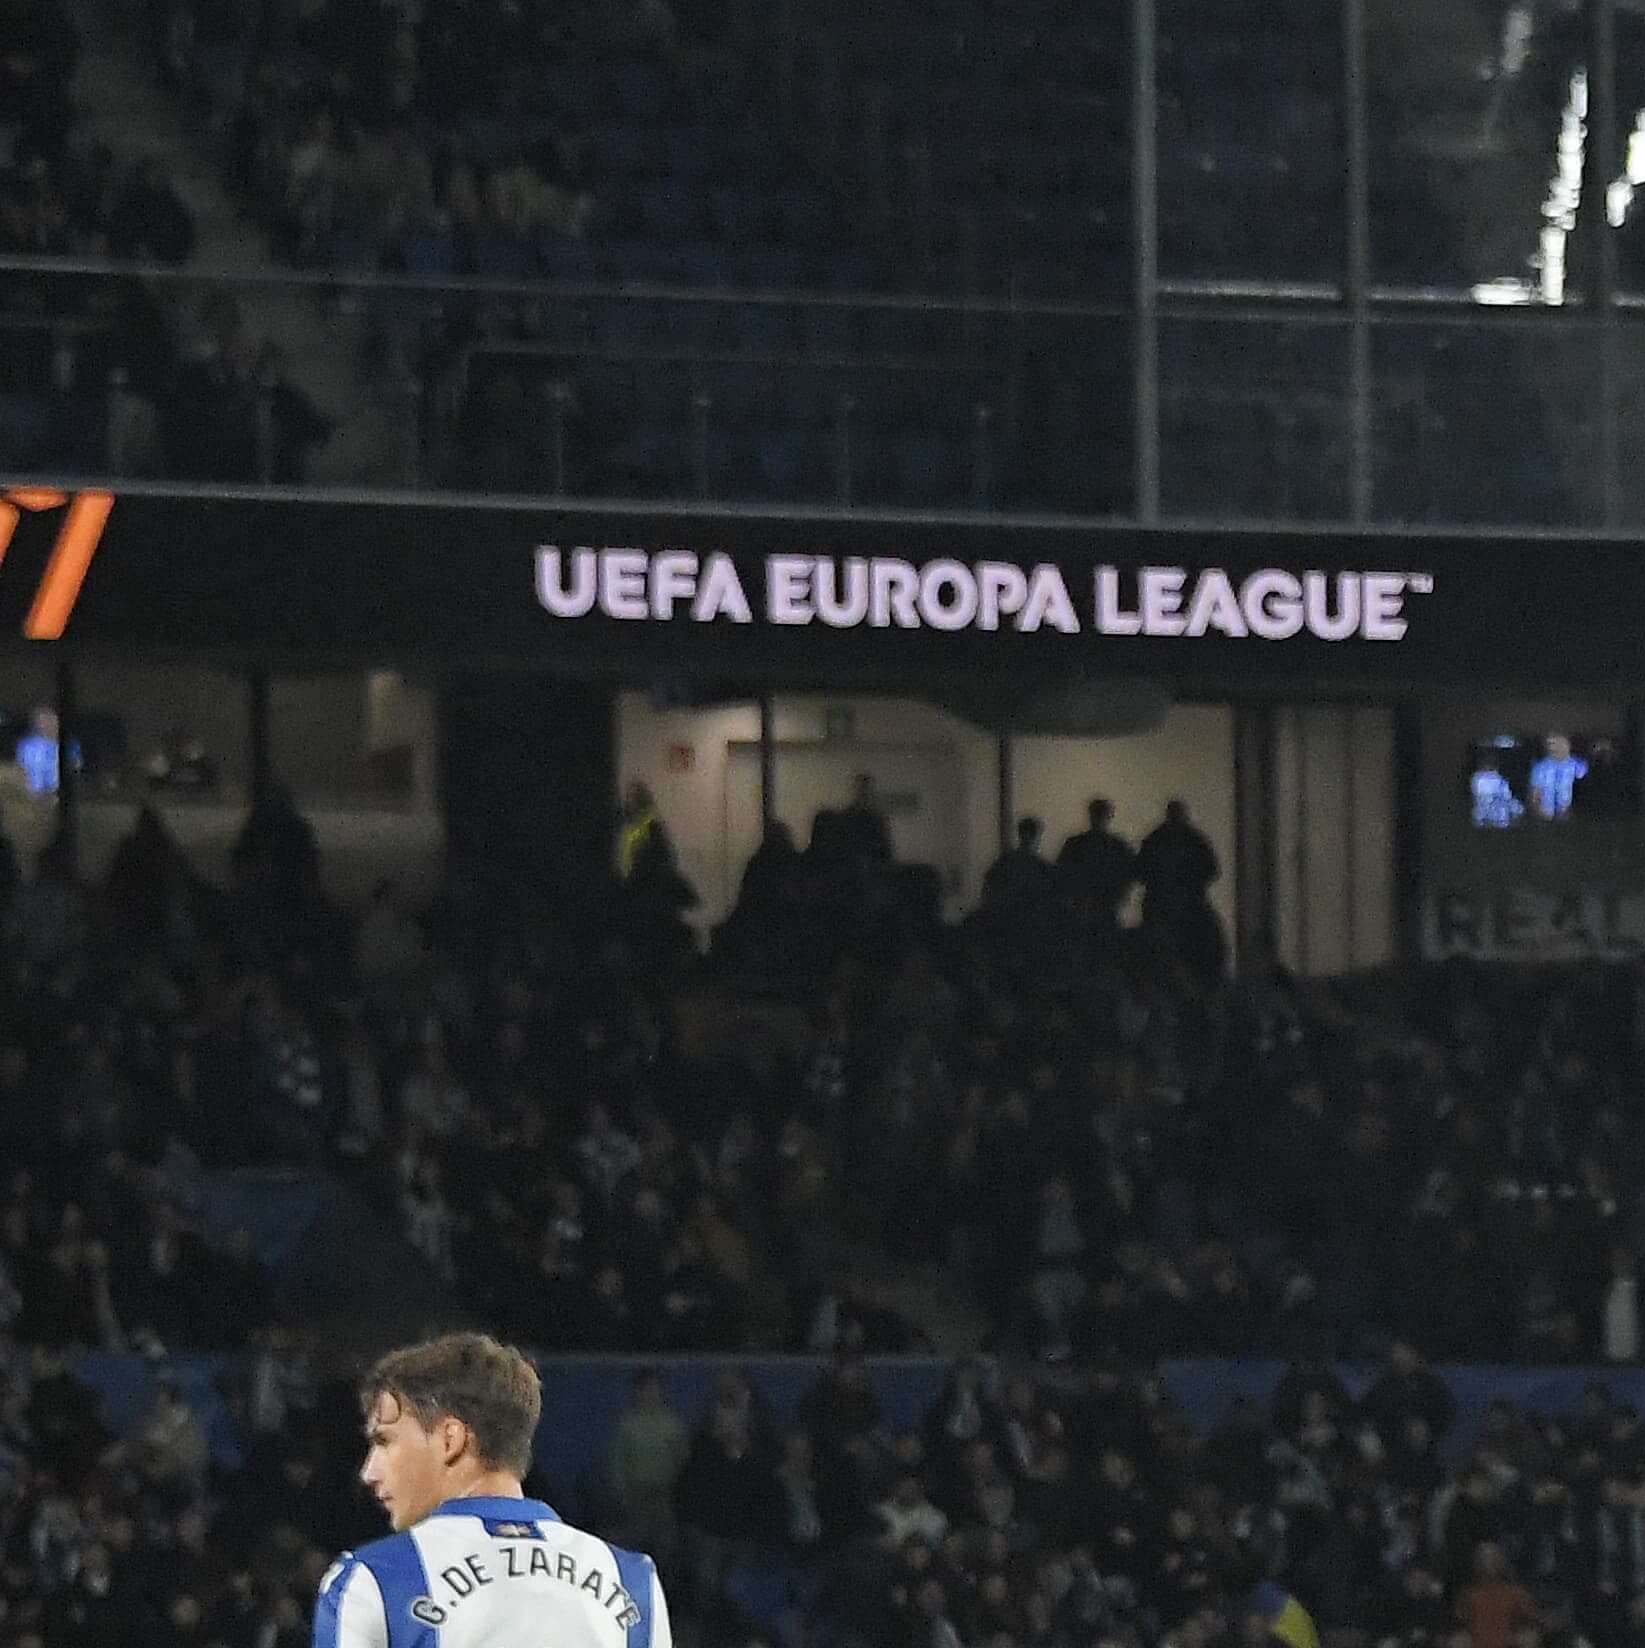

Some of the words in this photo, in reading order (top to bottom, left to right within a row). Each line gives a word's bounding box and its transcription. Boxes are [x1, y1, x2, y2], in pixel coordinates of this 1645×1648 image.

[534, 546, 753, 623] UEFA
[766, 553, 1081, 634] EUROPA
[1434, 889, 1641, 952] REAL
[499, 1547, 642, 1631] ZARATE
